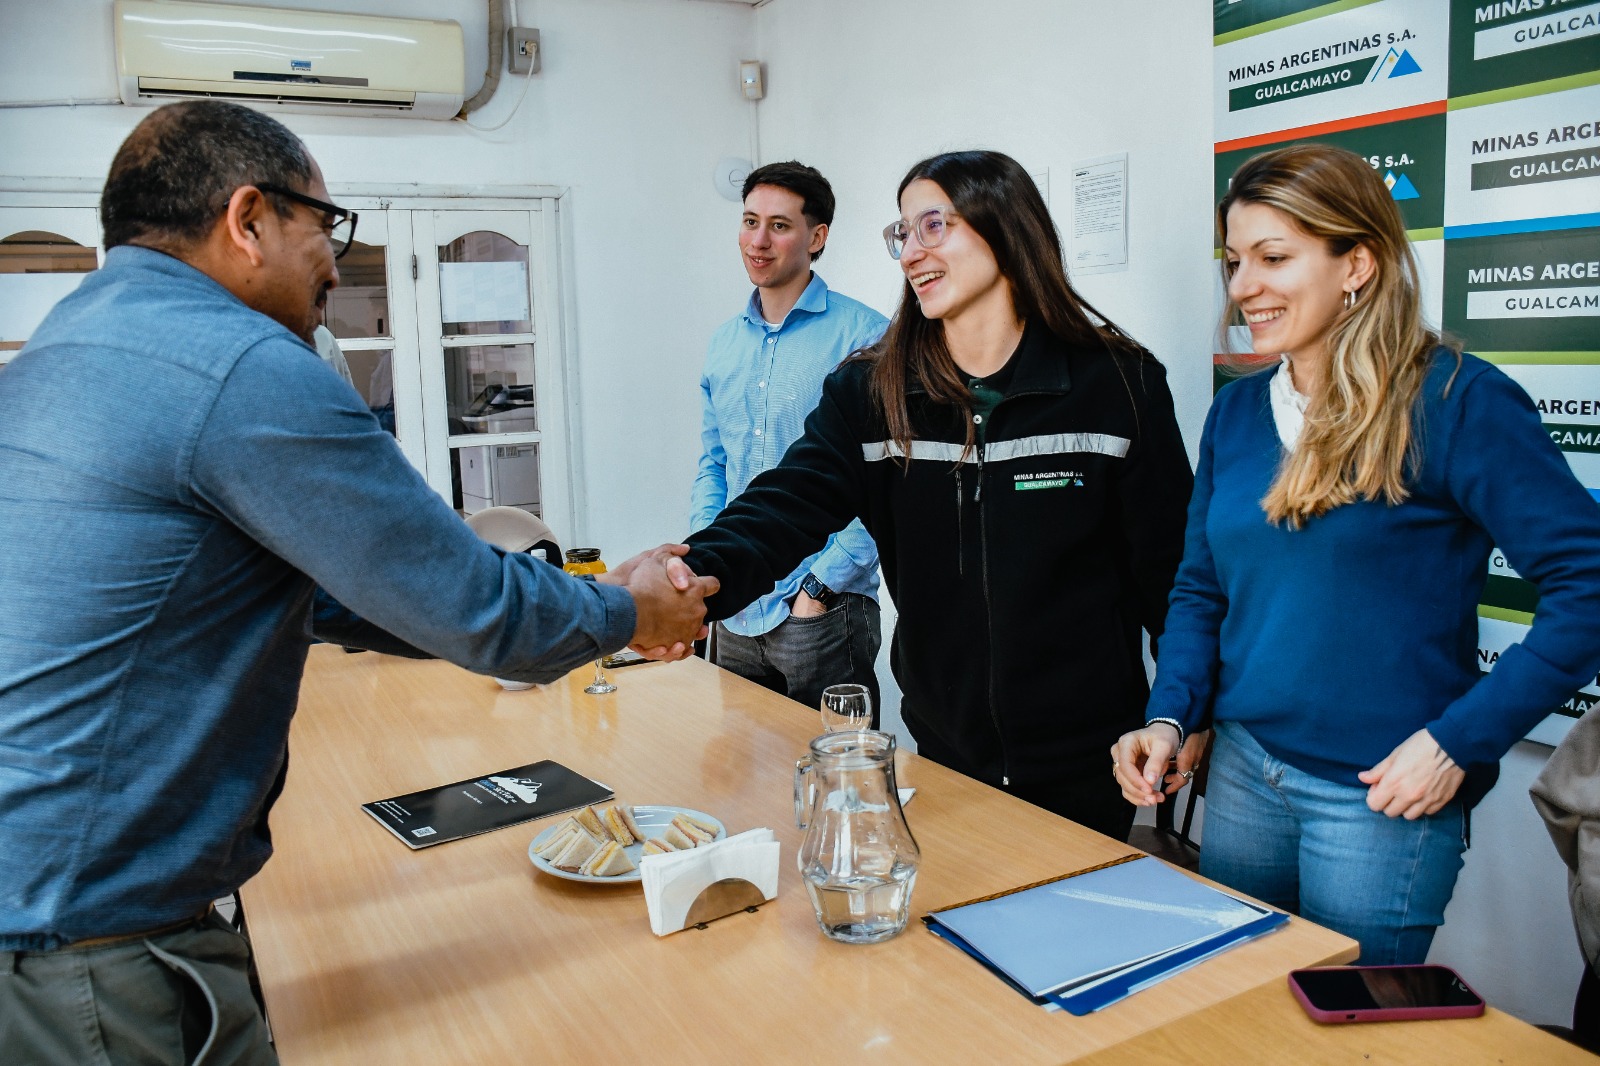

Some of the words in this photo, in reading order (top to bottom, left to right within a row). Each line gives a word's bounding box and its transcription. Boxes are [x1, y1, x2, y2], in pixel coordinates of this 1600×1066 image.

[1475, 0, 1545, 24] MINAS
[1514, 11, 1600, 43] GUALCA
[1228, 61, 1275, 83] MINAS
[1279, 33, 1381, 71] ARGENTINAS
[1254, 69, 1352, 101] GUALCAMAYO
[1472, 131, 1539, 155] MINAS
[1468, 265, 1534, 284] MINAS
[1540, 261, 1600, 280] ARGE
[1505, 295, 1600, 311] GUALCAM
[1023, 480, 1063, 488] GUALCAMAYO
[1035, 471, 1074, 479] ARGENTINAS
